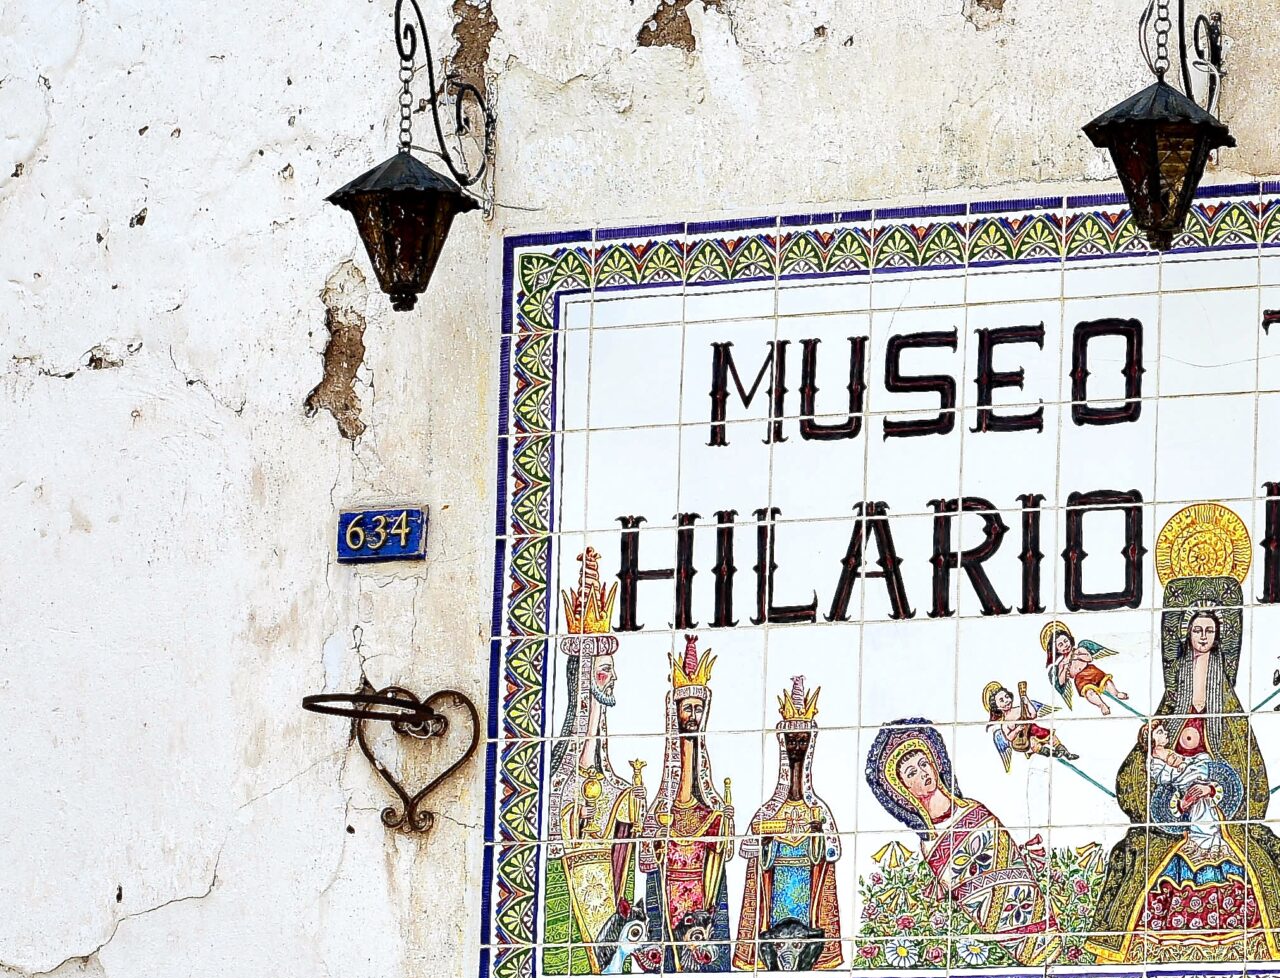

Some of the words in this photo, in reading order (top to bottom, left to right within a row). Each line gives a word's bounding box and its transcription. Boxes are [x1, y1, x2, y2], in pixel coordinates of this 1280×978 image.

[707, 317, 1146, 447] MUSEO
[345, 510, 411, 549] 634
[613, 489, 1147, 632] HILARIO
